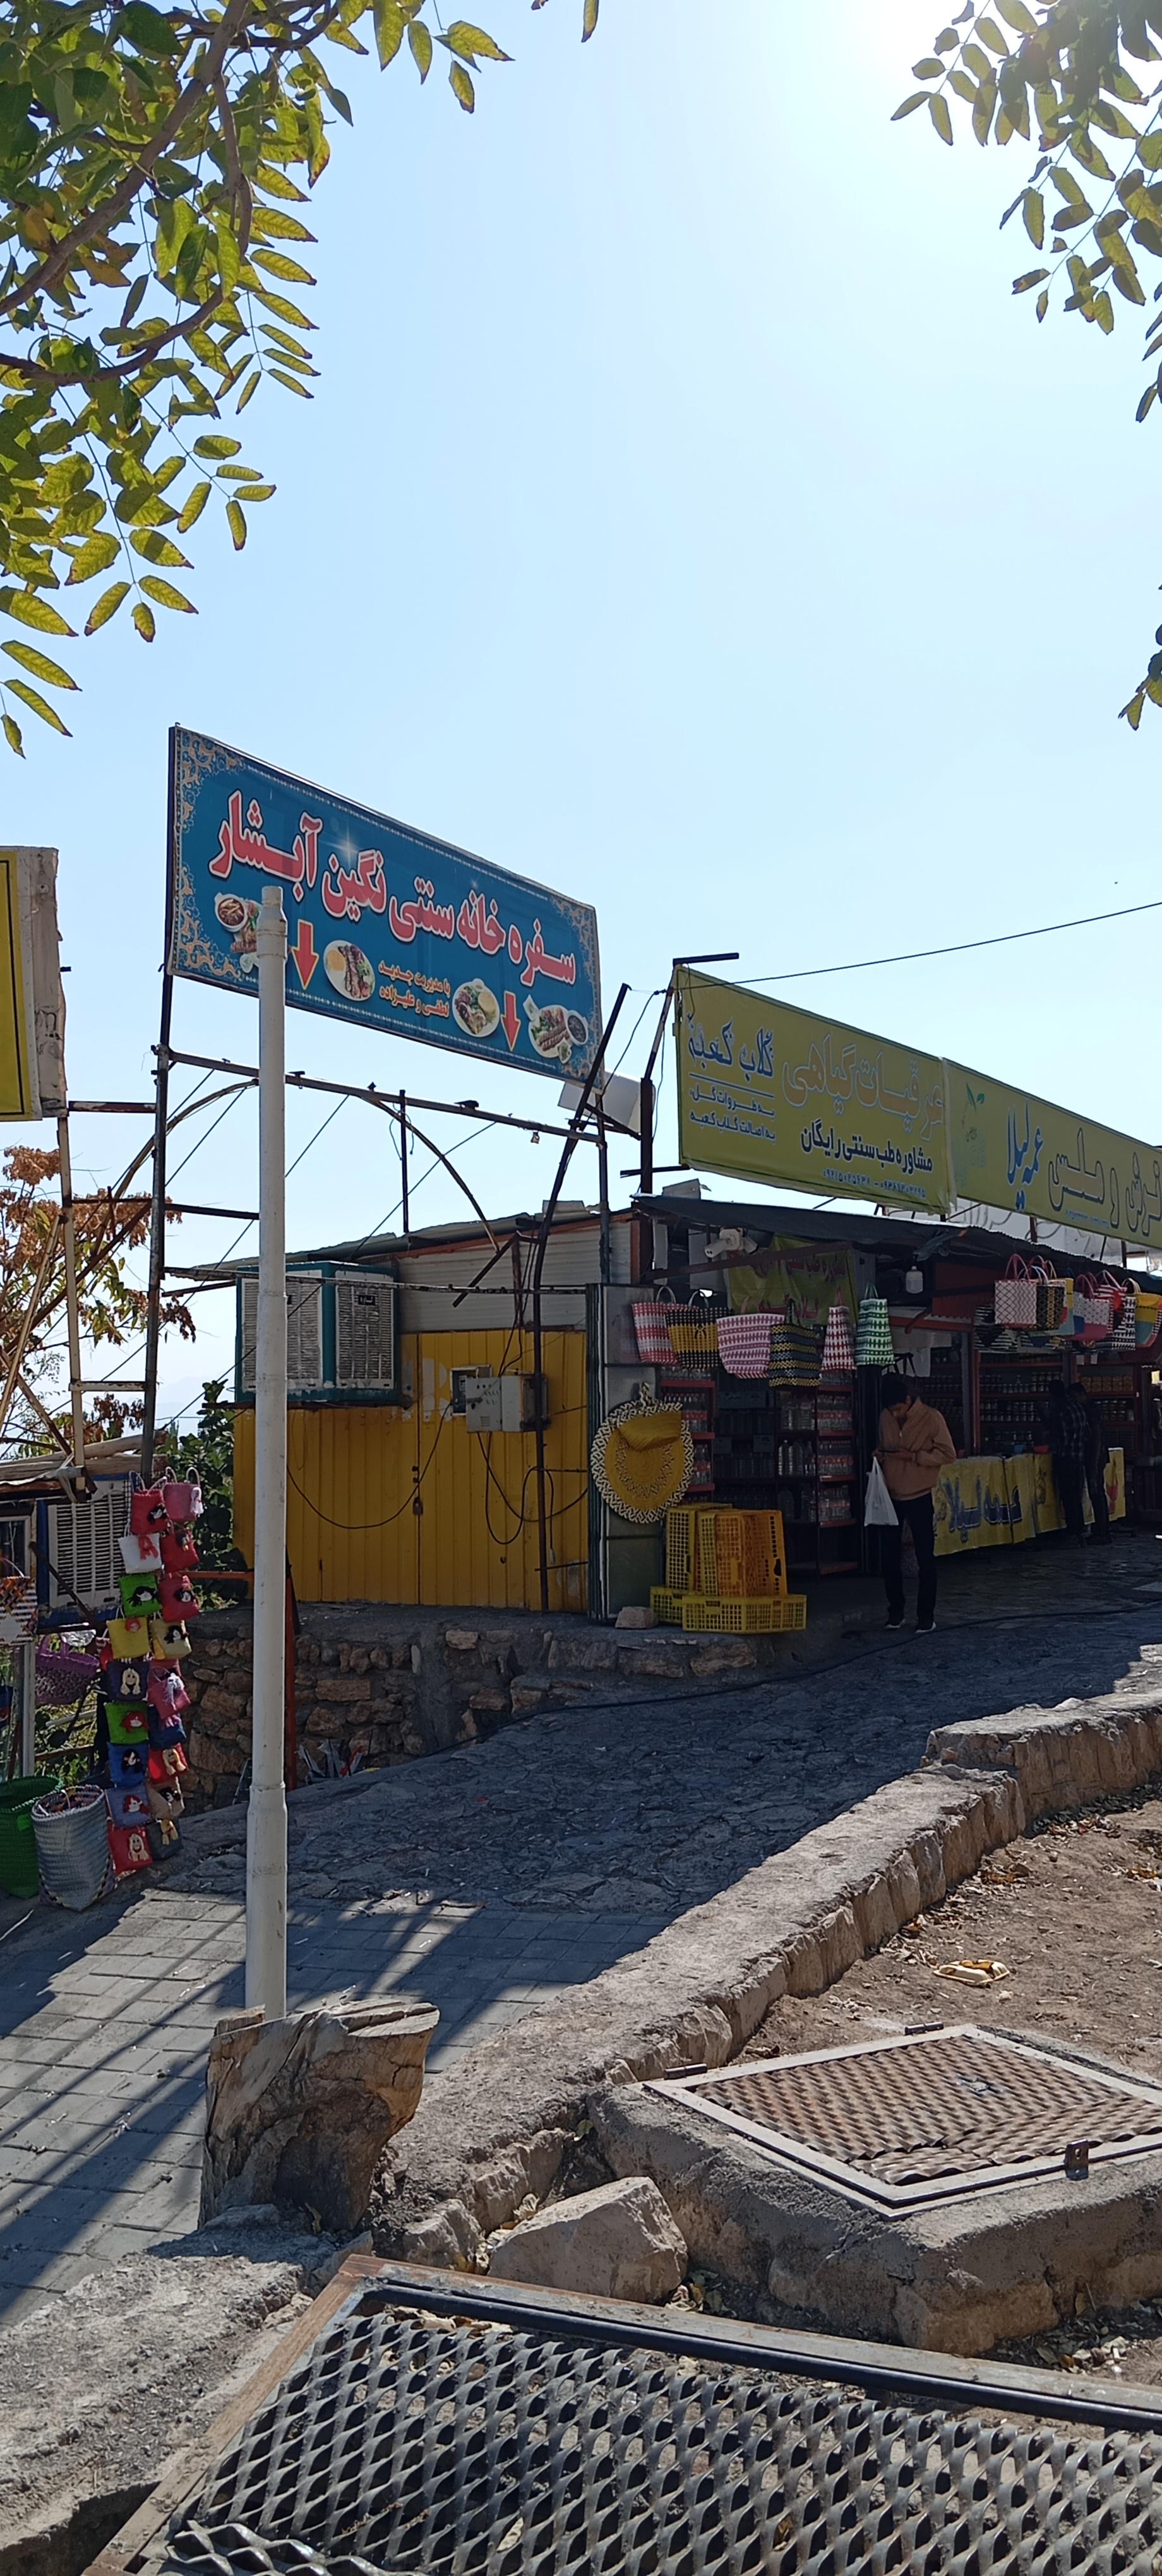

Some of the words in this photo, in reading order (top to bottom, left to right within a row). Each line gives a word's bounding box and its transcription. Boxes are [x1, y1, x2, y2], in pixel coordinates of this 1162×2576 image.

[208, 790, 323, 902] آبشار
[321, 849, 387, 921] نگین
[389, 877, 455, 942] سنتی
[456, 889, 506, 954] خانه
[378, 960, 414, 986] جدید
[509, 919, 575, 986] سفره
[379, 984, 414, 1008] علیزاده
[414, 972, 443, 993] مدیریت
[443, 977, 451, 998] با
[415, 998, 422, 1013] و
[422, 999, 449, 1017] لطفی
[687, 1017, 734, 1070] کعبه
[739, 1026, 774, 1082] گلاب
[782, 1032, 856, 1115] گیاهی
[758, 1104, 775, 1121] به
[855, 1051, 944, 1141] عرقیات
[690, 1111, 716, 1128] کعبه
[717, 1113, 739, 1131] گلاب
[740, 1119, 765, 1138] اصالت
[765, 1128, 776, 1145] به
[801, 1119, 842, 1160] رایگان
[842, 1136, 876, 1162] سنتی
[876, 1140, 895, 1168] طب
[895, 1144, 933, 1174] مشاوره
[1007, 1099, 1030, 1212] لیلا
[1021, 1126, 1043, 1185] عمه
[1048, 1127, 1105, 1212] ملس
[1110, 1167, 1120, 1229] و
[944, 1474, 982, 1543] لیلا
[983, 1484, 1022, 1526] عمه
